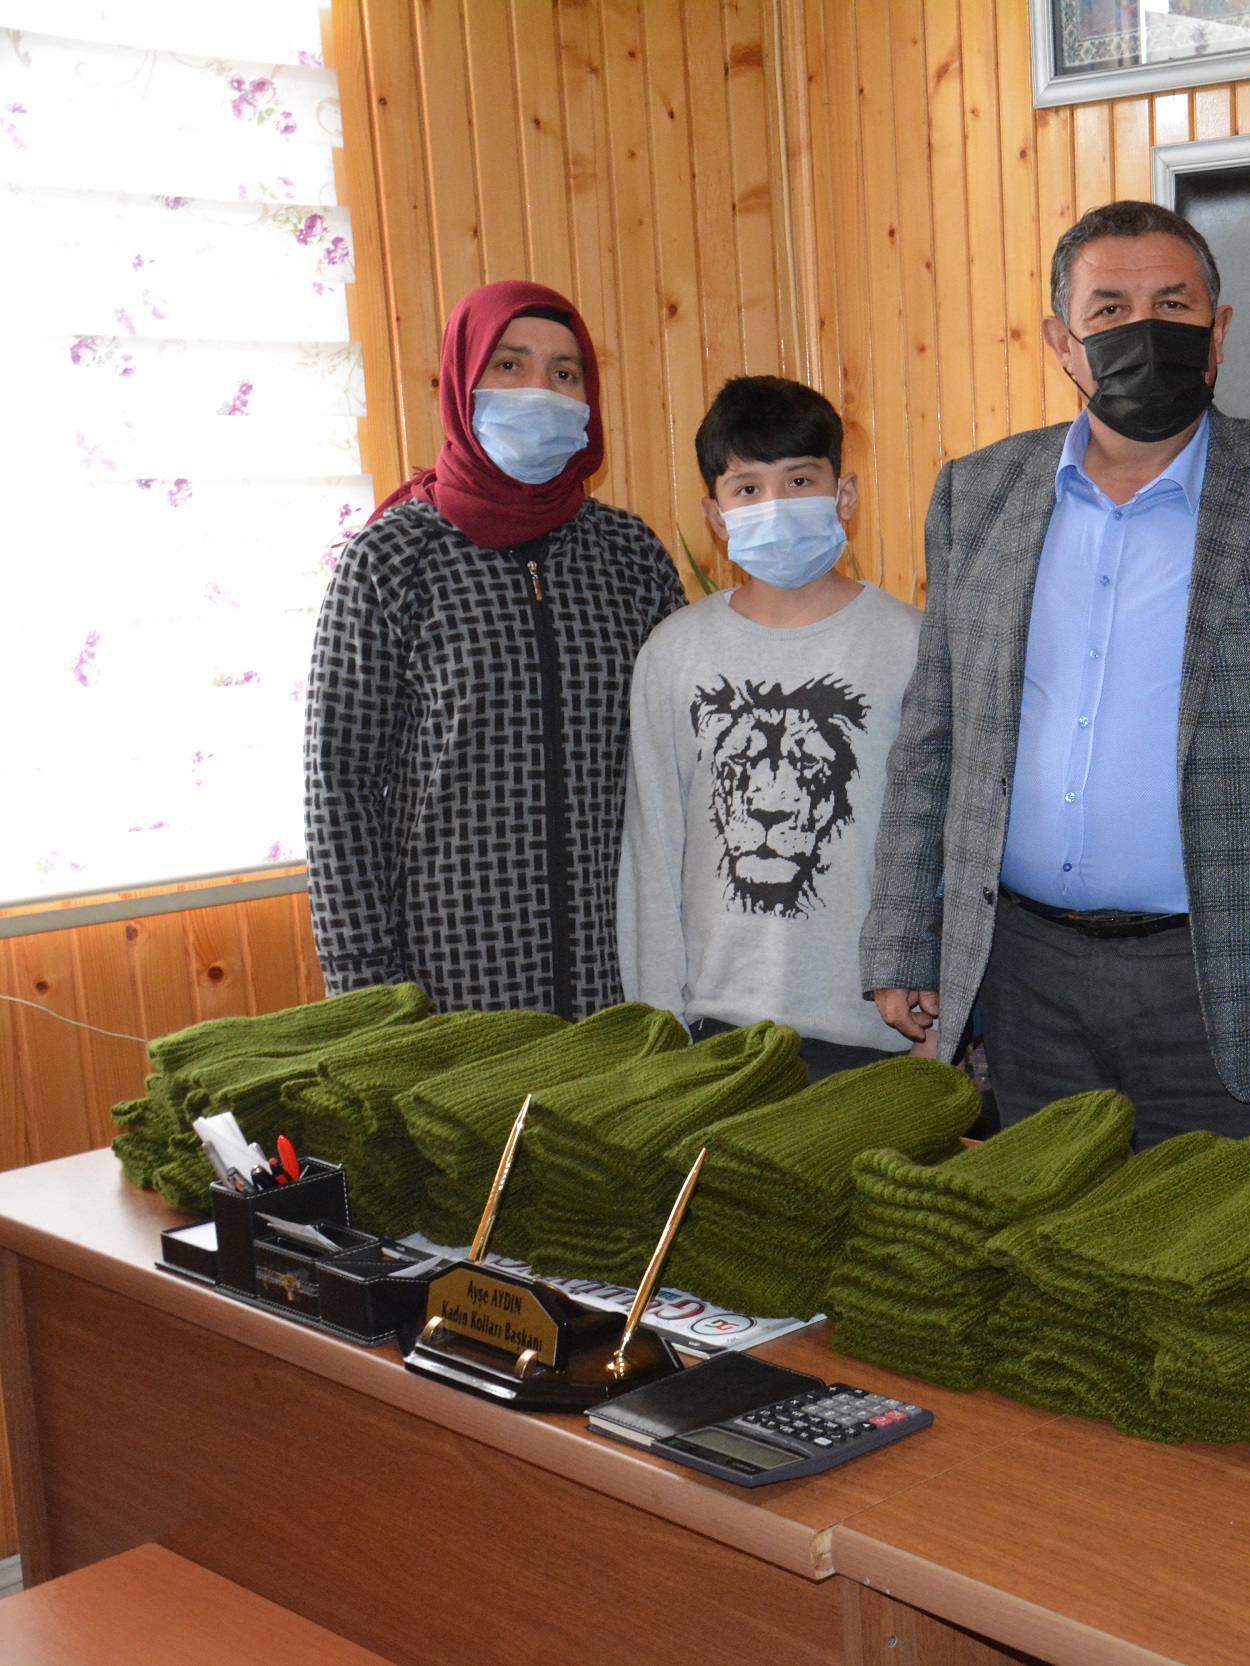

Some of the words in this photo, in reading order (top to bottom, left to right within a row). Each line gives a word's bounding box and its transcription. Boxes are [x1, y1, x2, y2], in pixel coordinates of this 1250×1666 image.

[466, 1280, 489, 1307] Ayşe
[490, 1288, 522, 1314] AYDIN
[442, 1300, 468, 1325] Kadın
[470, 1310, 502, 1337] Kolları
[505, 1322, 543, 1352] Başkanı
